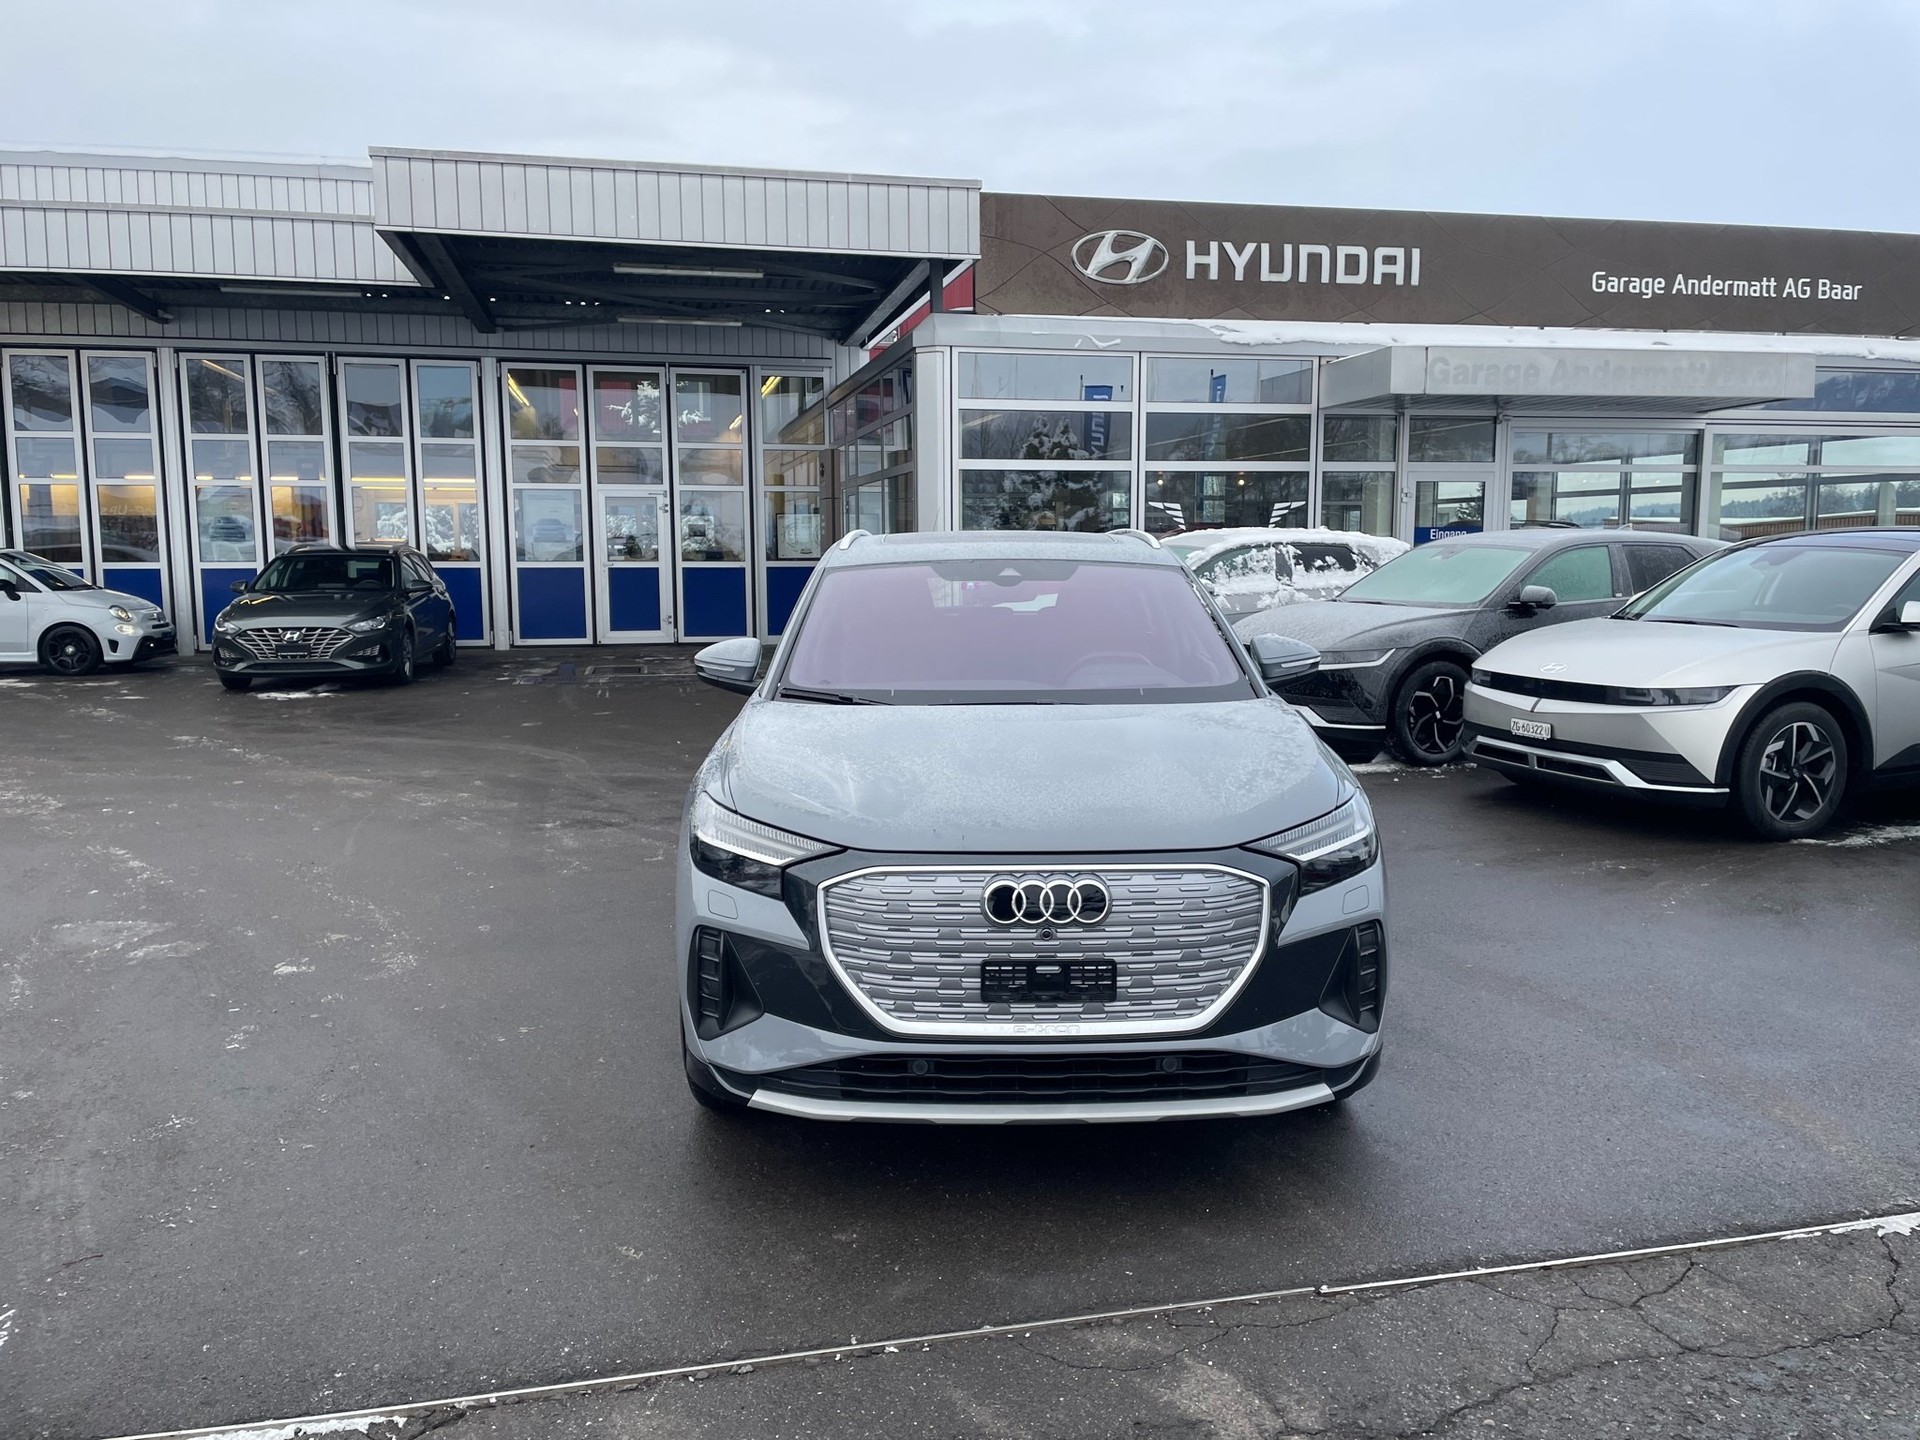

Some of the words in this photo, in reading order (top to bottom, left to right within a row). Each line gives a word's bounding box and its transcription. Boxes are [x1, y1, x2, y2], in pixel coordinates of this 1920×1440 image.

[1186, 240, 1420, 286] HYUNDAI
[1591, 271, 1666, 299] Garage
[1671, 273, 1777, 298] Andermatt
[1782, 277, 1811, 299] AG
[1817, 278, 1863, 301] Baar
[1428, 356, 1540, 387] Garage
[1012, 1023, 1081, 1034] e-tron
